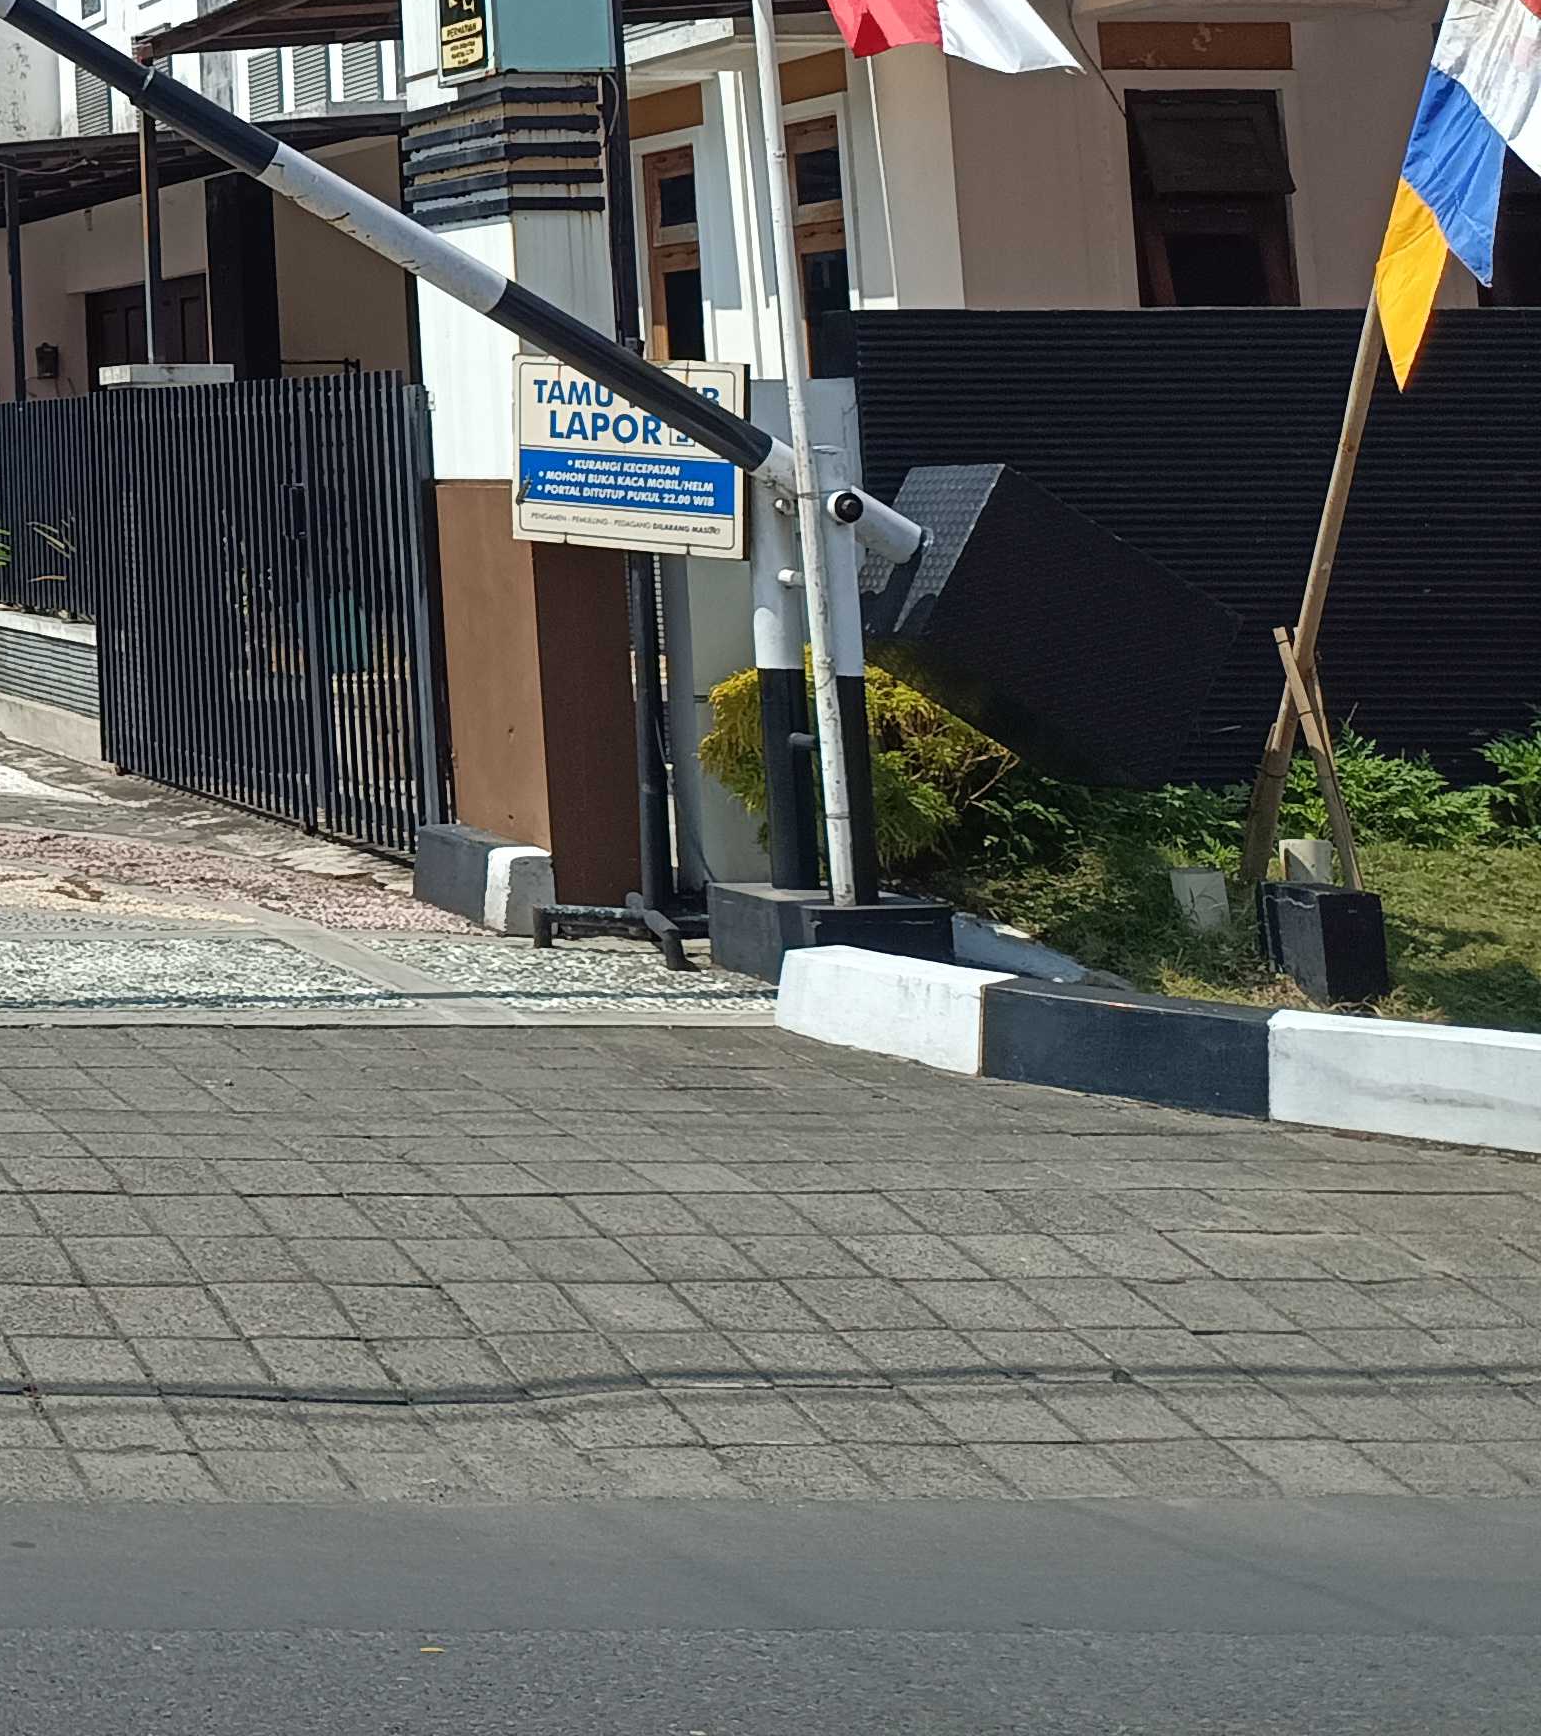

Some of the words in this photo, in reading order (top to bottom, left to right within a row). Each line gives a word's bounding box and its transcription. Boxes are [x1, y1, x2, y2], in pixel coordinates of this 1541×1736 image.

[533, 379, 614, 407] TAMU
[549, 410, 662, 446] LAPOR
[574, 459, 621, 472] KURANGI
[623, 462, 680, 476] KECEPATAN
[545, 470, 585, 483] MOHON
[587, 473, 615, 485] BUKA
[617, 475, 645, 487] KACA
[646, 478, 714, 492] MOBIL/HELM
[544, 484, 580, 496] PORTAL
[582, 487, 626, 499] DITUTUP
[627, 490, 660, 503] PUKUL
[662, 493, 691, 505] 22.00
[692, 495, 715, 507] WIB
